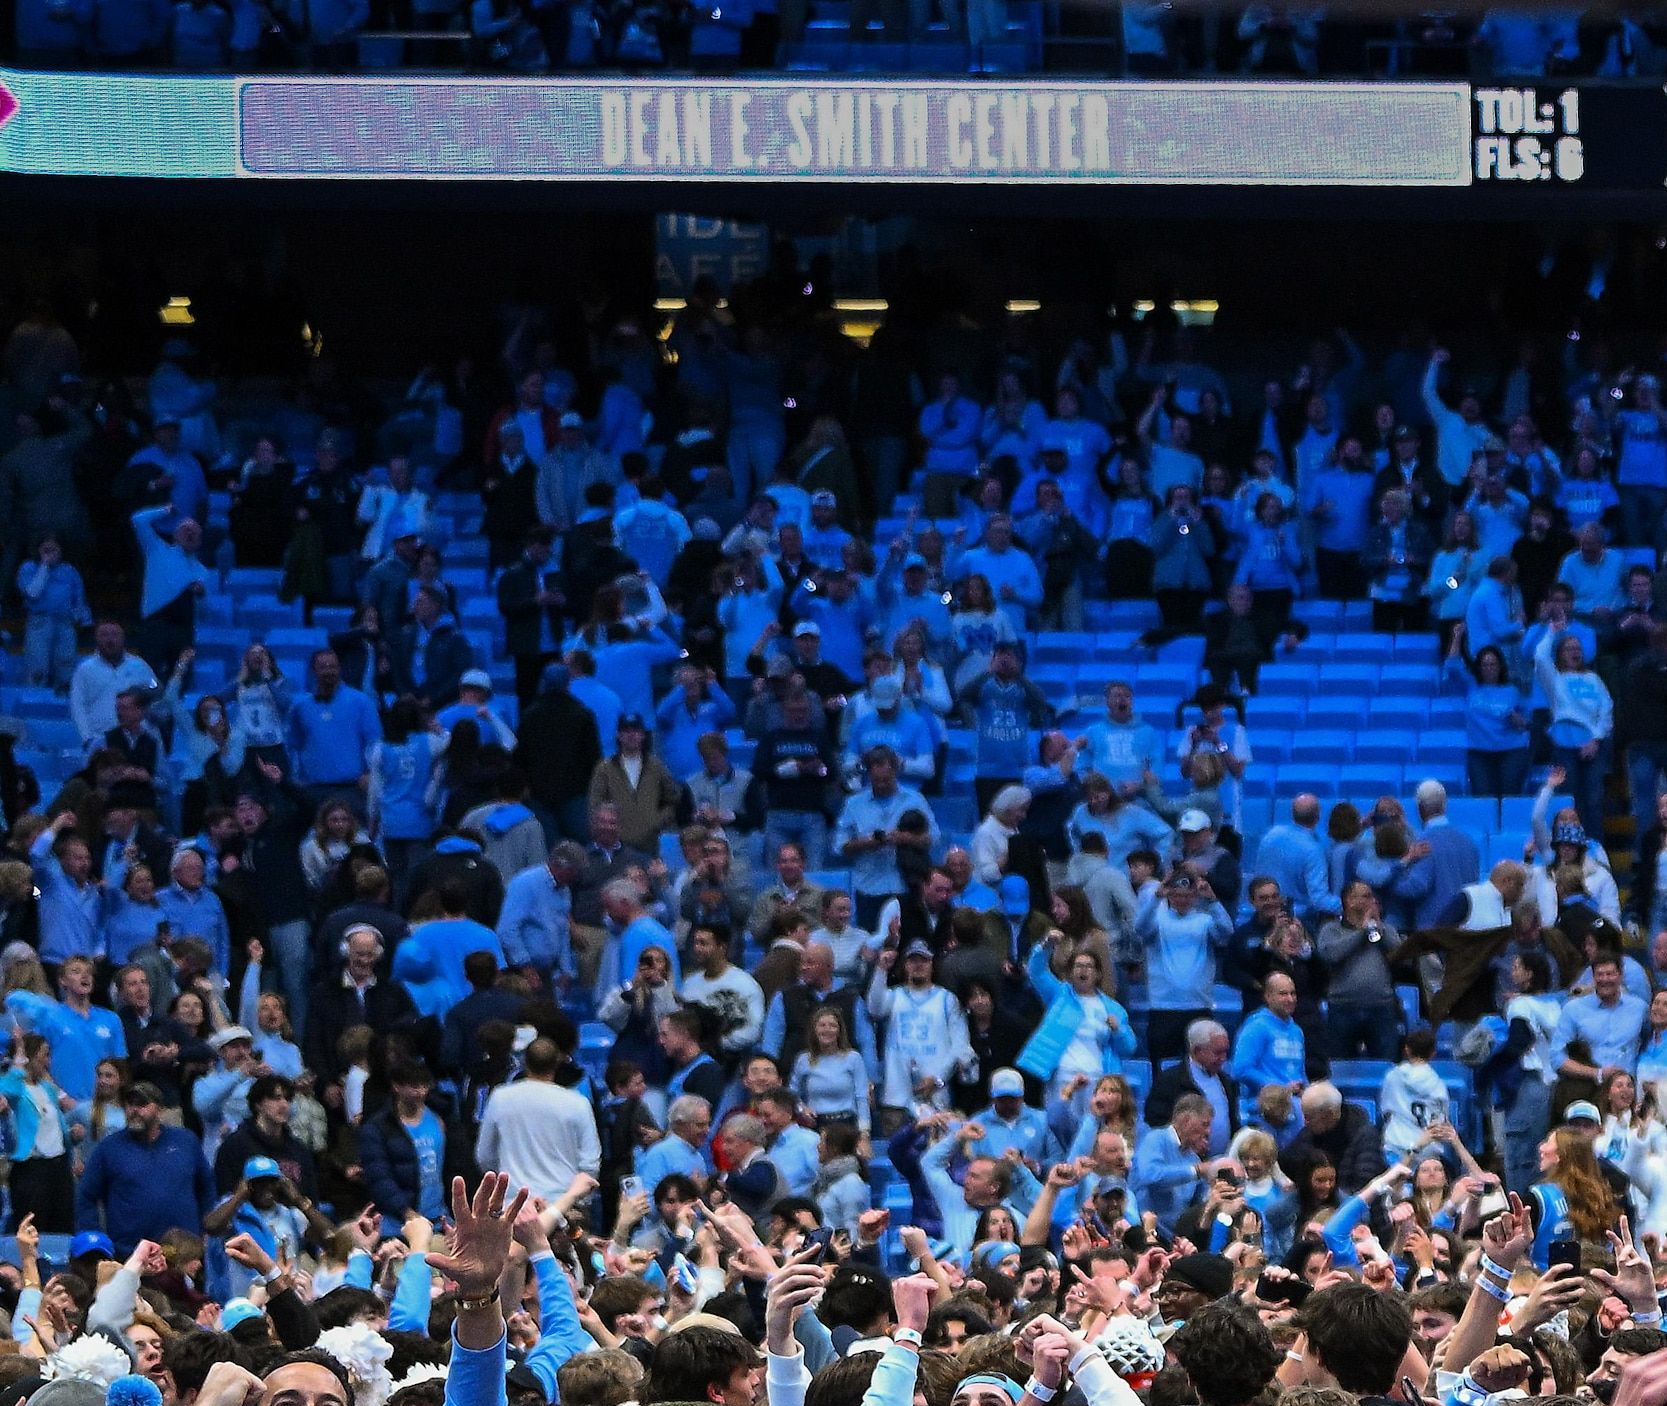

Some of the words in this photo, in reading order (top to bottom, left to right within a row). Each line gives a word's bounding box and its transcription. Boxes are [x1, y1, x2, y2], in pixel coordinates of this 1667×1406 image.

[601, 91, 712, 168] DEAN
[731, 91, 770, 168] E.
[787, 91, 929, 168] SMITH
[947, 91, 1111, 169] CENTER
[1559, 87, 1580, 135] 1
[1475, 136, 1553, 182] FLS:
